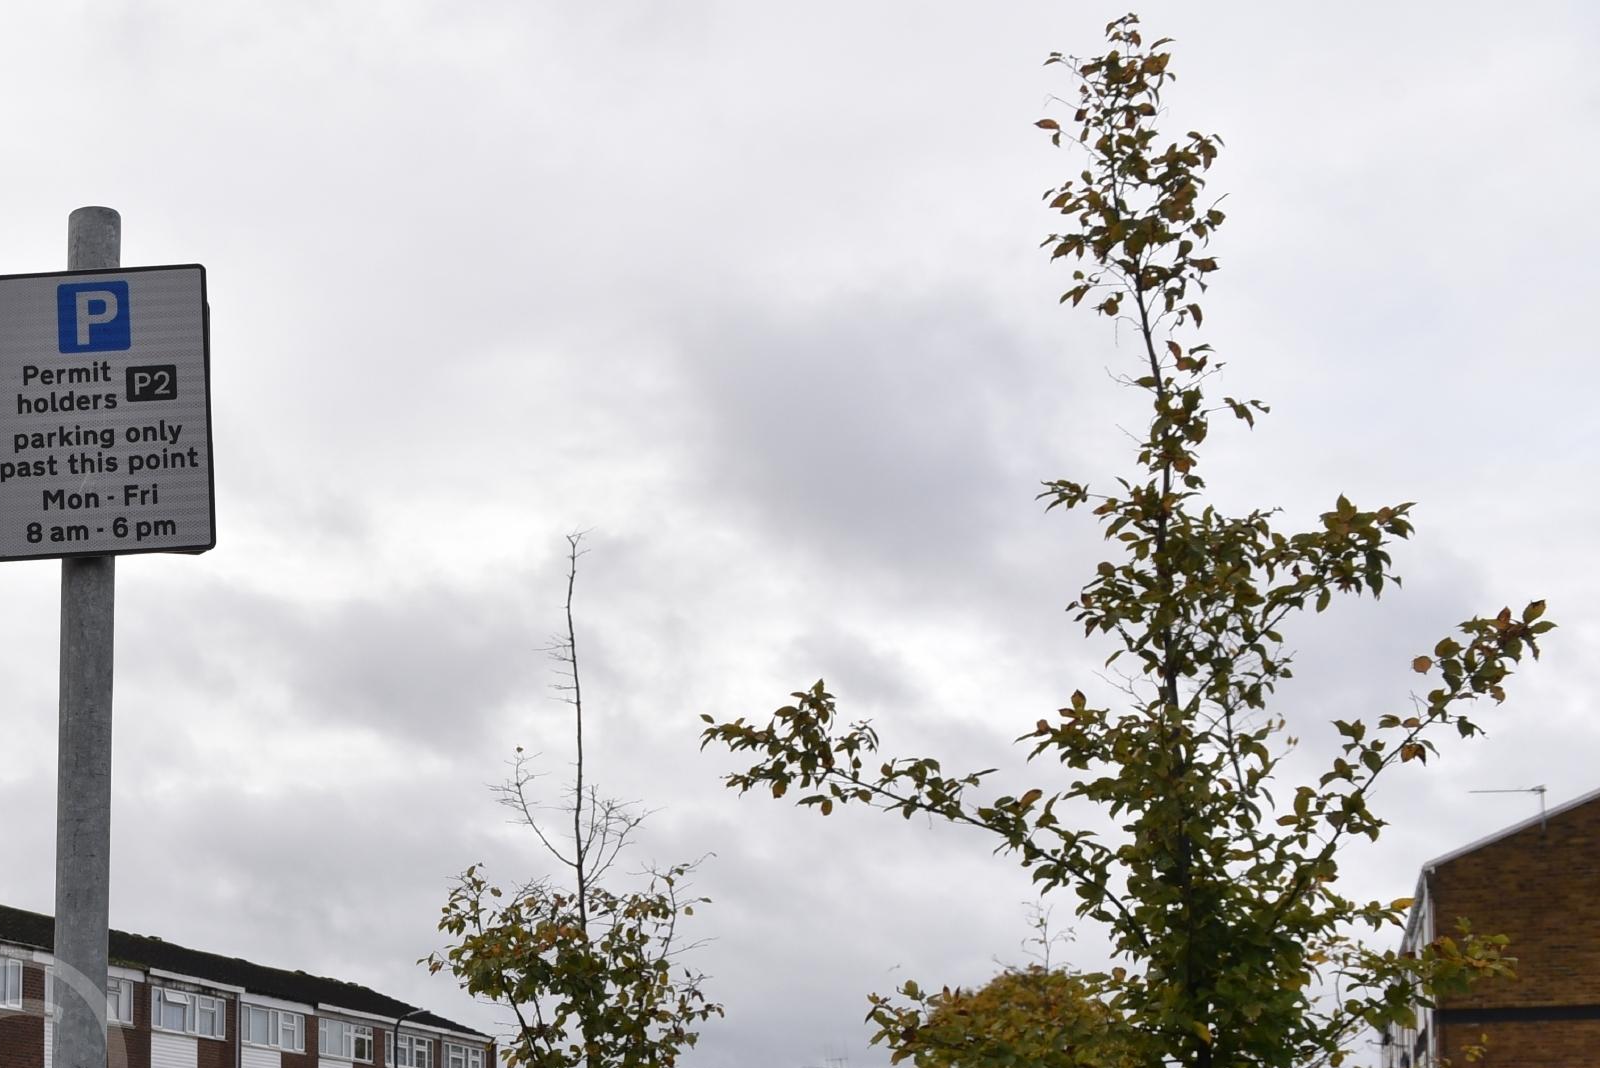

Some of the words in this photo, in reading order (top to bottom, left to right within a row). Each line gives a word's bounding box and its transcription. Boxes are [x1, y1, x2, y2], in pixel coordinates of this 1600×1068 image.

[75, 290, 118, 346] P
[22, 360, 112, 386] Permit
[133, 370, 172, 396] P2
[17, 390, 118, 414] holders
[13, 425, 115, 453] parking
[125, 419, 183, 445] only
[0, 455, 58, 483] past
[68, 452, 119, 475] this
[128, 446, 199, 475] point
[42, 489, 100, 511] Mon
[123, 483, 159, 507] Fri
[26, 522, 43, 544] 8
[49, 524, 90, 542] am
[112, 517, 129, 539] 6
[135, 518, 177, 542] pm
